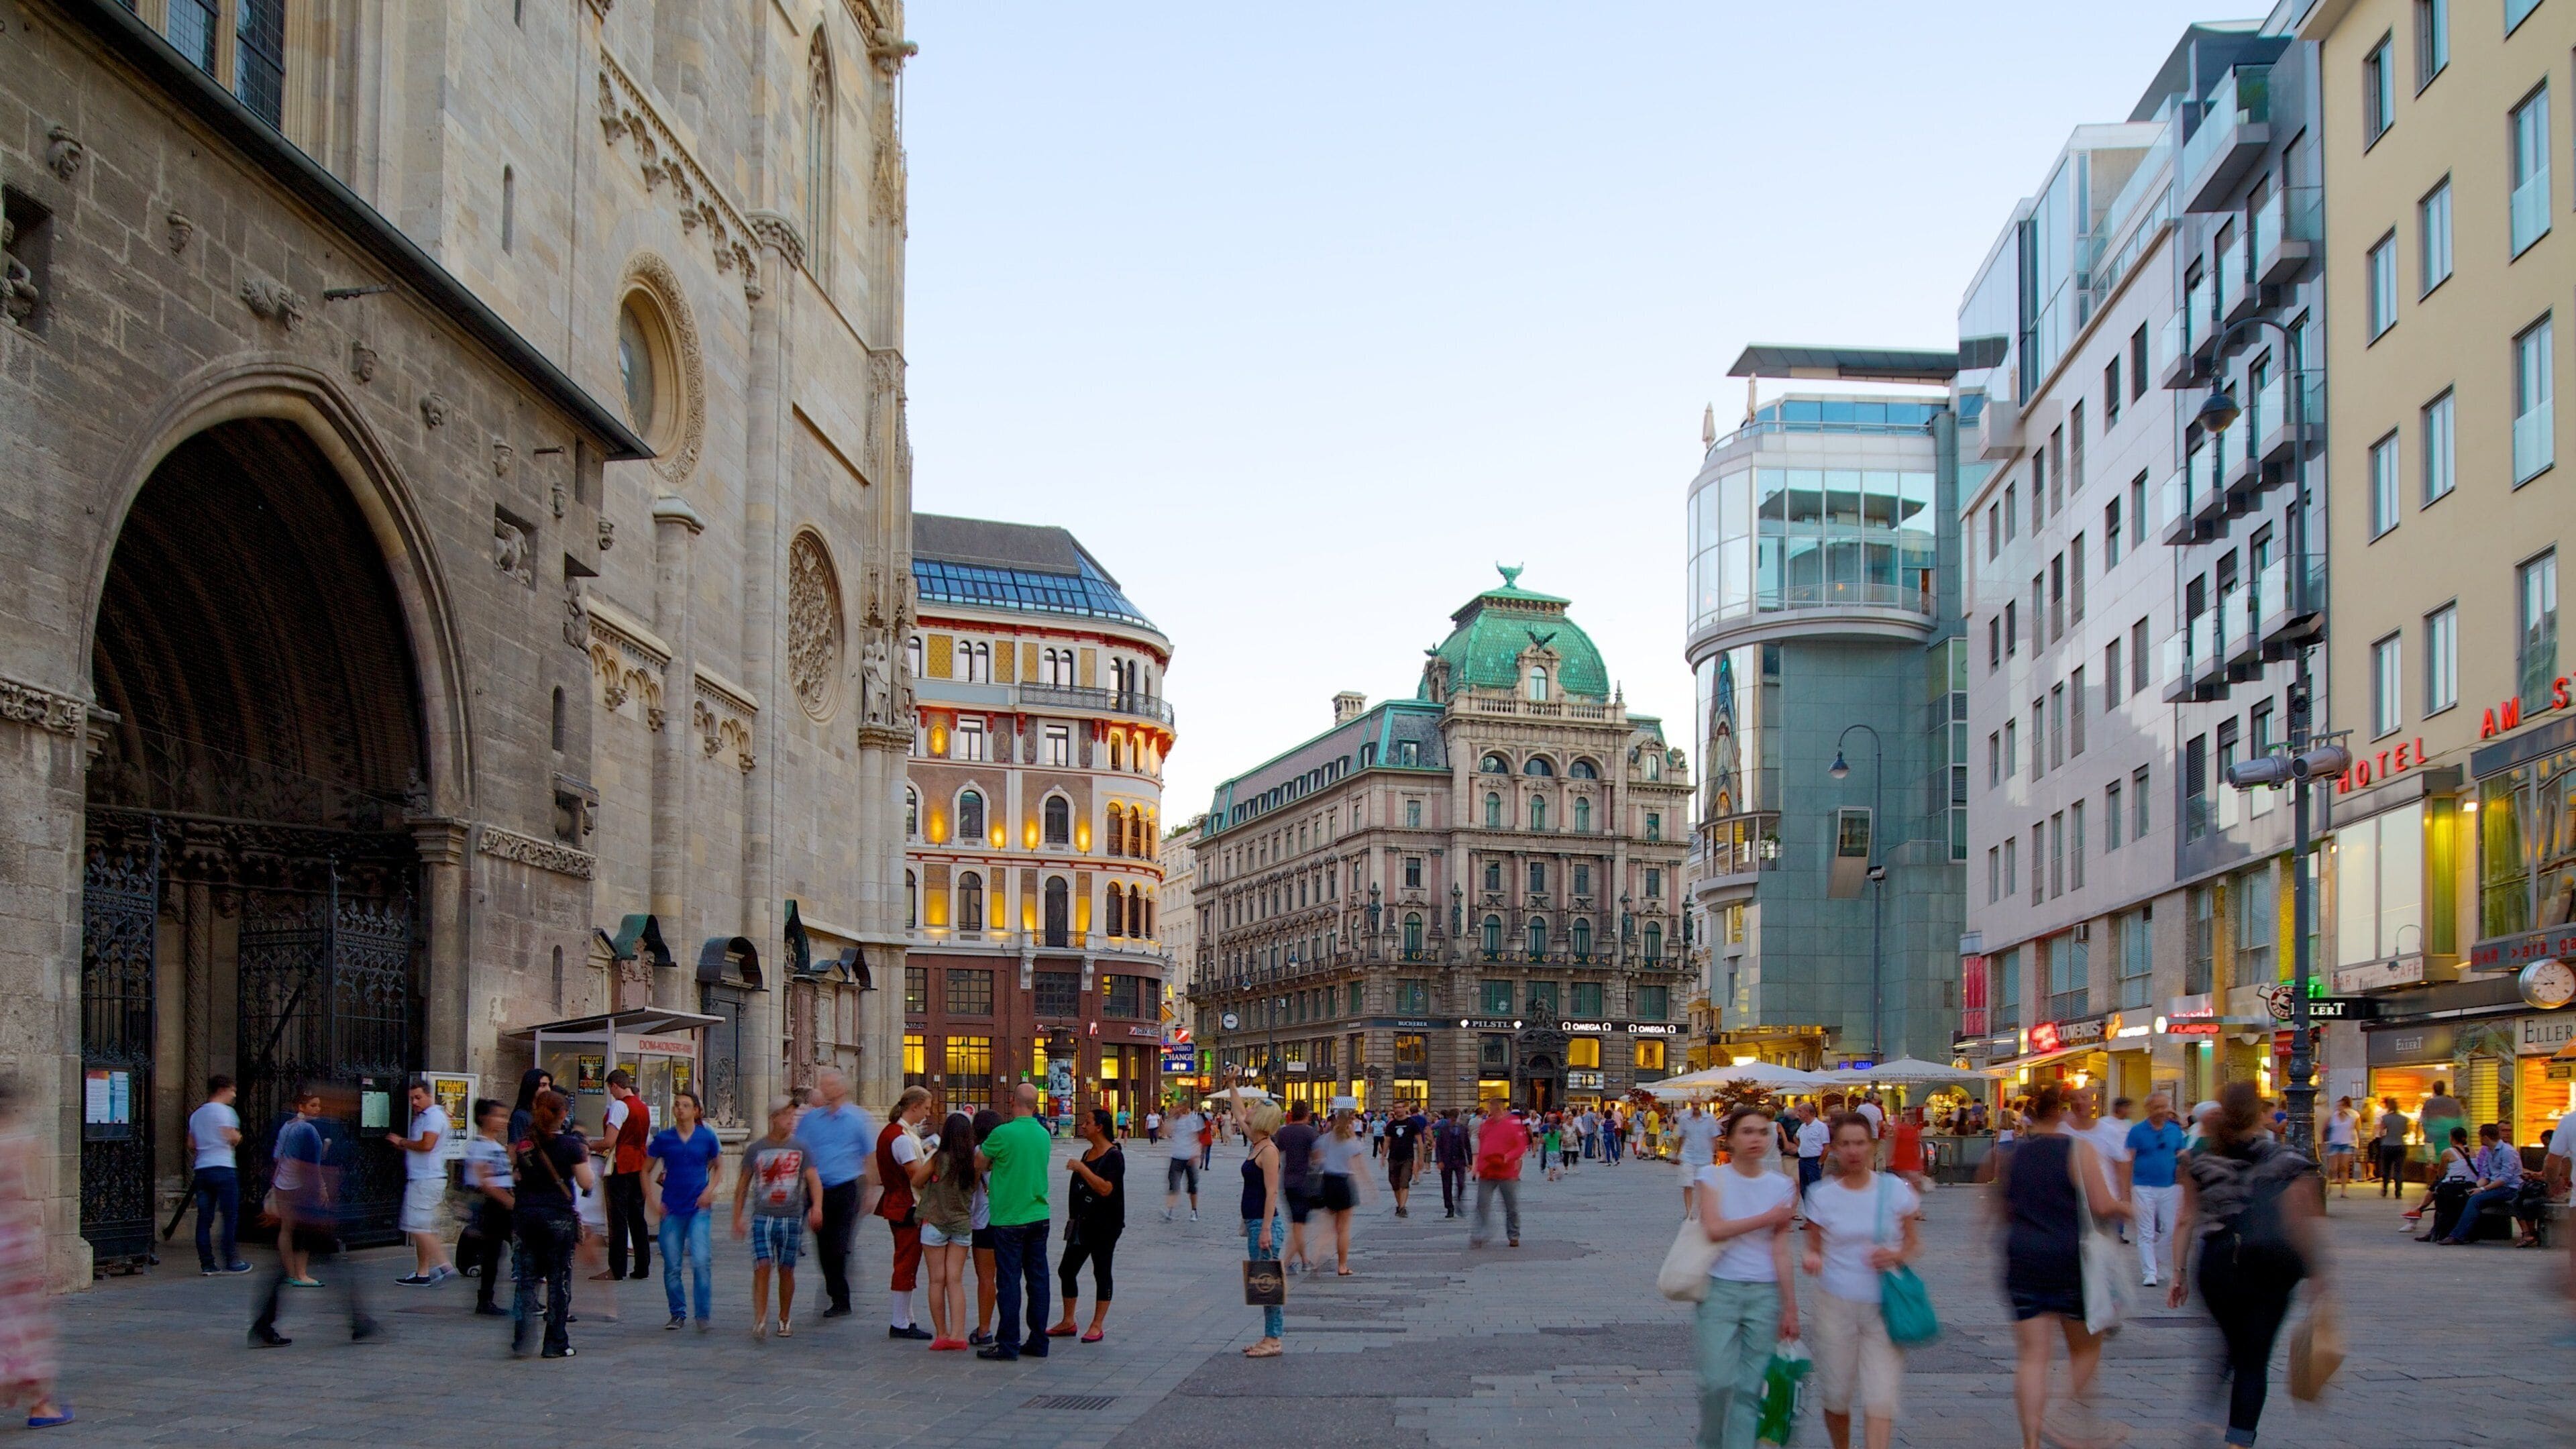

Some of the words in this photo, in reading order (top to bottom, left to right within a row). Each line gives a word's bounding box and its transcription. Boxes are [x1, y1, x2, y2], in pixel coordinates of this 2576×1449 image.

[2337, 737, 2426, 795] HOTEL
[2481, 696, 2520, 739] AM
[2473, 947, 2499, 966] BAR
[2332, 975, 2351, 989] BAR
[2290, 1002, 2345, 1015] LERT
[1472, 1020, 1510, 1028] PILSTL
[2057, 1020, 2101, 1041] OUVENIRS
[2524, 1016, 2576, 1044] ELLER
[2396, 1036, 2423, 1051] ELLERT
